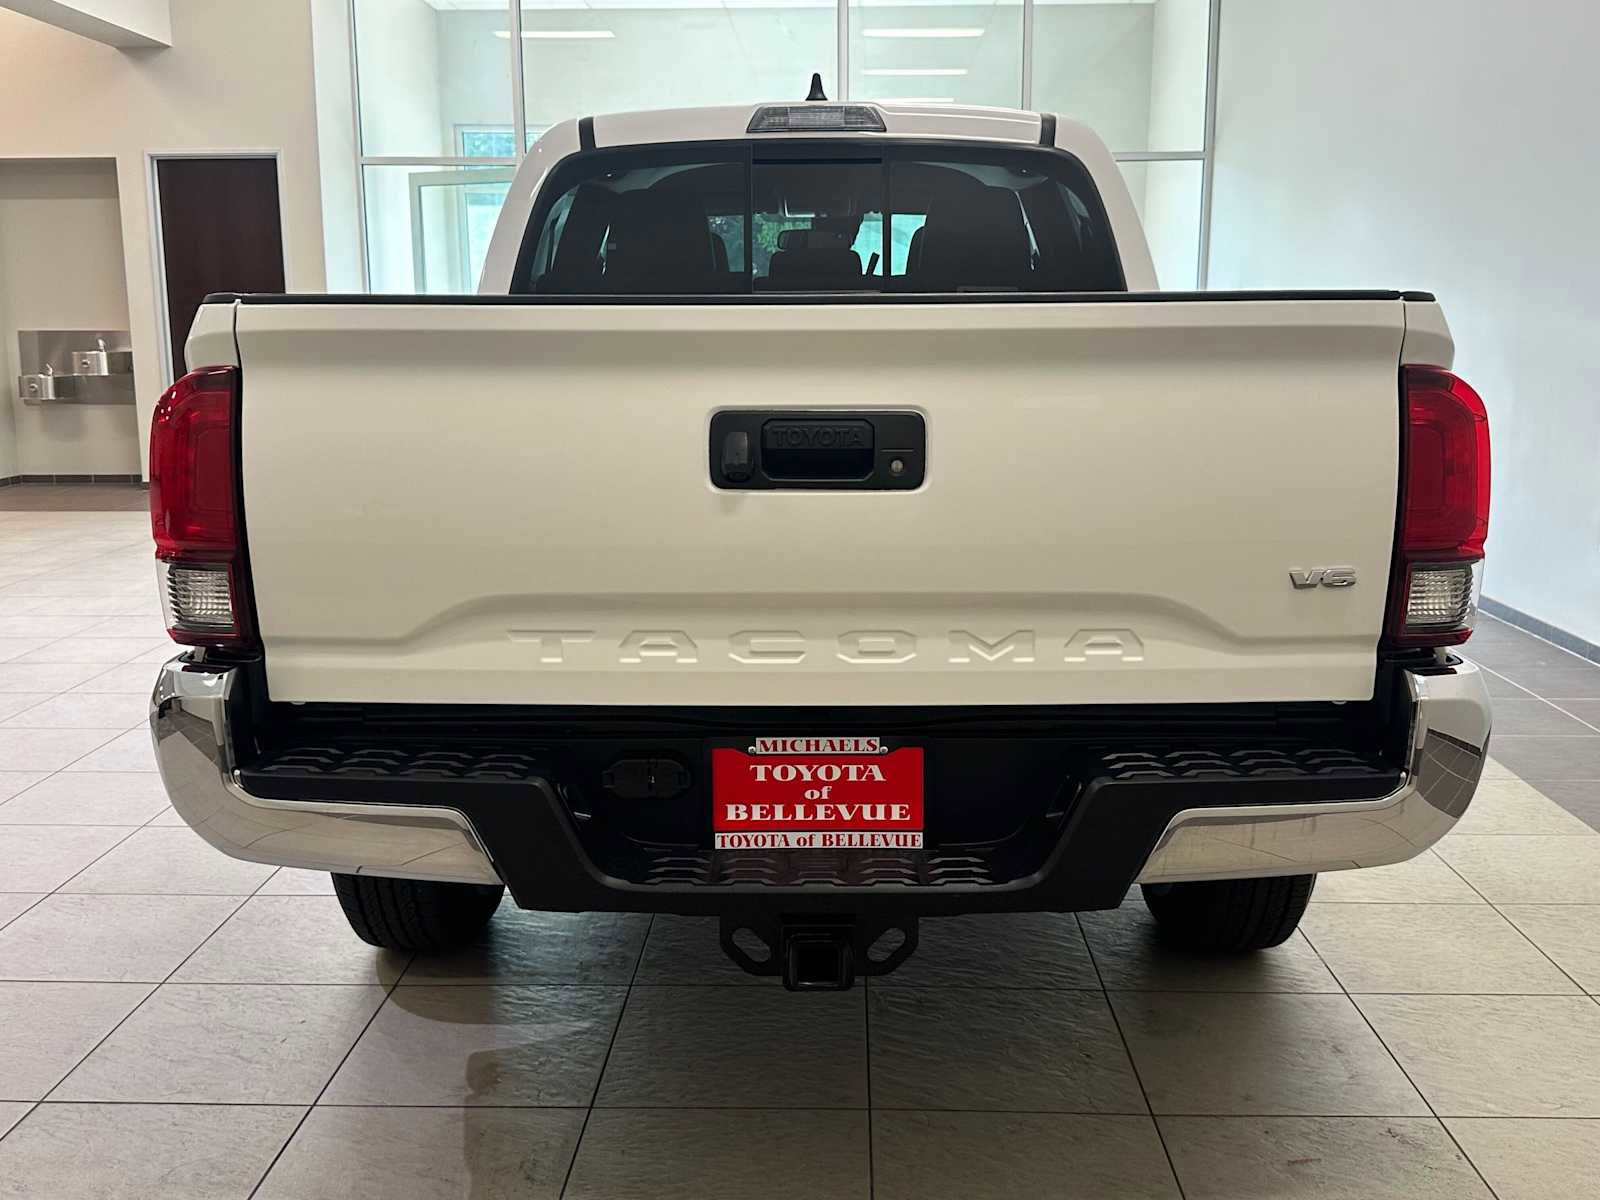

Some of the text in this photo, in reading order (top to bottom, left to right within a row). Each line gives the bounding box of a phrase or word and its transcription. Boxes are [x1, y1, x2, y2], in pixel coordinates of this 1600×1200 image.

[771, 426, 866, 447] TOYOTA
[1289, 567, 1356, 589] V6
[506, 629, 1144, 664] TACOMA
[759, 738, 878, 753] MICHAELS
[750, 764, 886, 782] TOYOTA
[804, 785, 832, 800] of
[725, 803, 911, 821] BELLEVUE
[717, 833, 922, 848] TOYOTA of BELLEVUE
